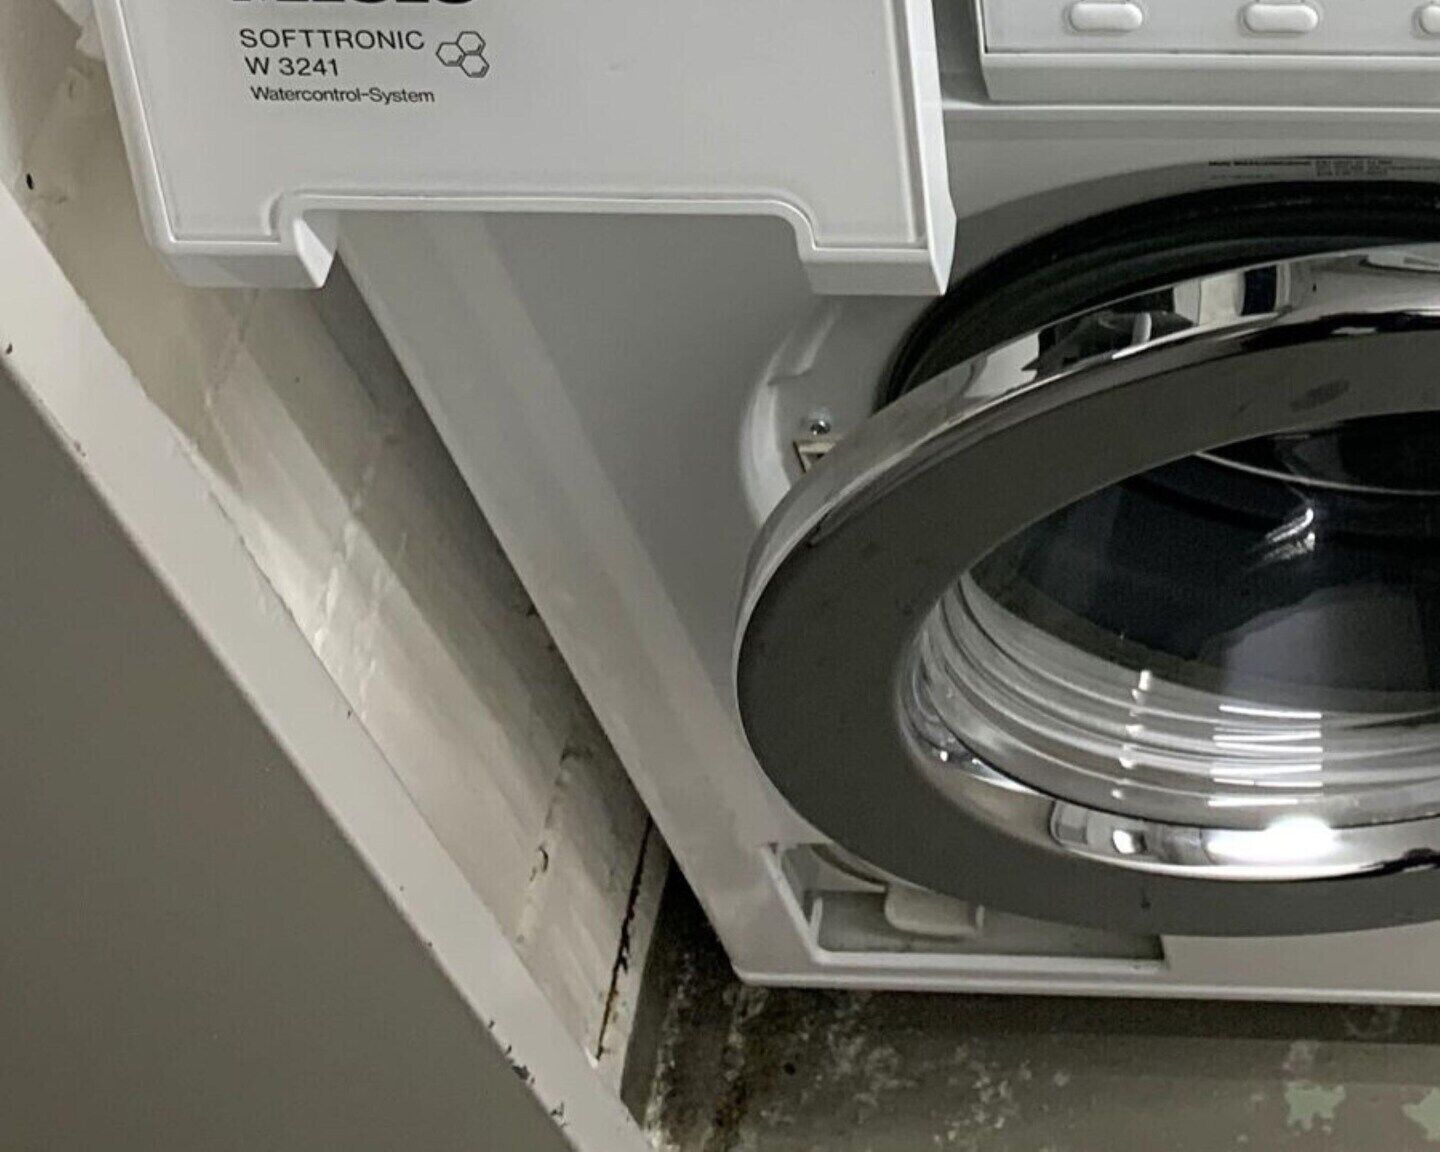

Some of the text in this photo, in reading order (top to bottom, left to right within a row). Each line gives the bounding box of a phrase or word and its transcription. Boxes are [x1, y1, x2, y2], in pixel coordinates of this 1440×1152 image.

[239, 28, 425, 50] SOFTTRONIC
[244, 56, 339, 77] W 3241
[249, 86, 435, 105] Watercontrol-System
